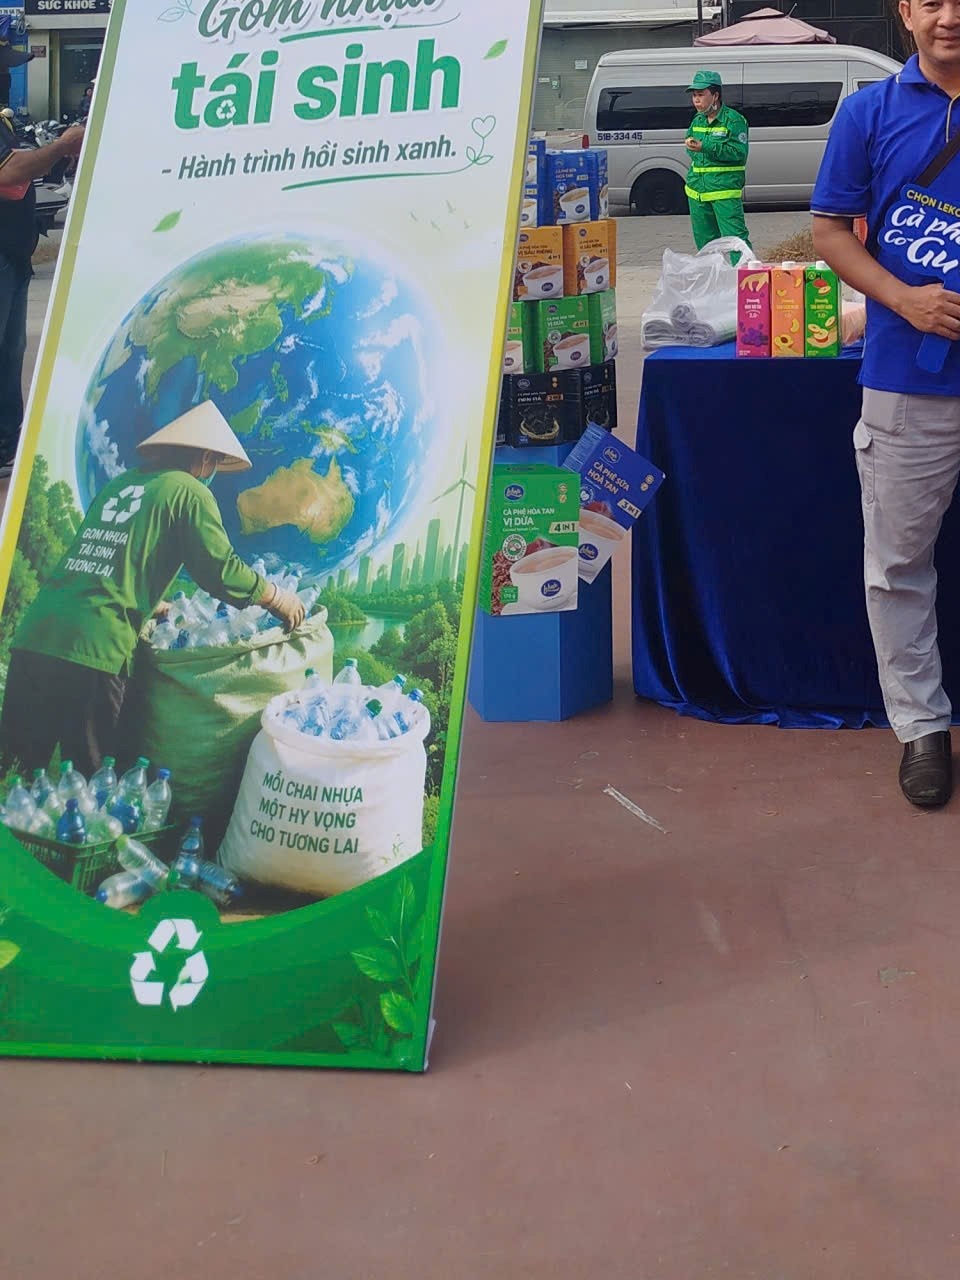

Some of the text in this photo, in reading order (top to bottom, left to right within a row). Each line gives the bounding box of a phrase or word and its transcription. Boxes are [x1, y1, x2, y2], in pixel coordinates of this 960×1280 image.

[171, 38, 462, 131] tái sinh
[178, 134, 457, 180] Hành trình hồi sinh xanh.
[907, 189, 937, 207] CHỌN
[891, 205, 926, 228] Cà
[907, 237, 959, 274] Gu
[82, 528, 105, 540] GOM
[554, 524, 561, 532] 4
[78, 542, 116, 560] TÁI SINH
[95, 563, 114, 577] LAI
[286, 780, 318, 801] CHAI
[321, 785, 363, 807] NHỰA
[259, 797, 356, 832] MỘT HY VỌNG
[250, 820, 360, 855] CHO TƯƠNG LAI
